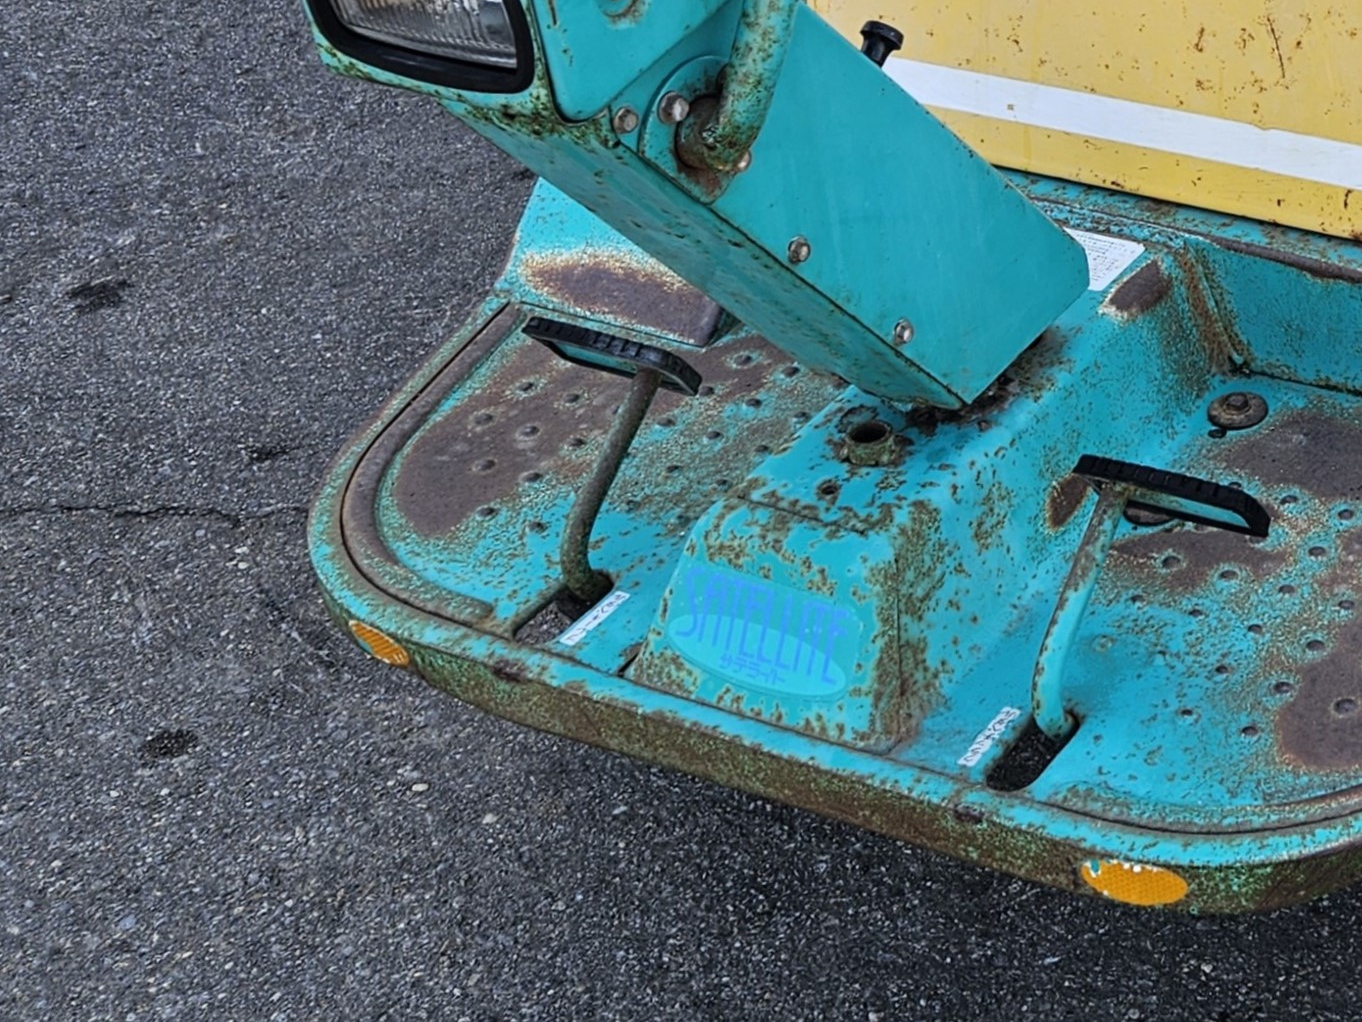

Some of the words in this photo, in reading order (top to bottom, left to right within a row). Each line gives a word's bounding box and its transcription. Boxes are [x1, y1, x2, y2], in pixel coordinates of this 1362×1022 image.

[675, 565, 850, 686] SATELLITE
[720, 653, 787, 686] サテライト
